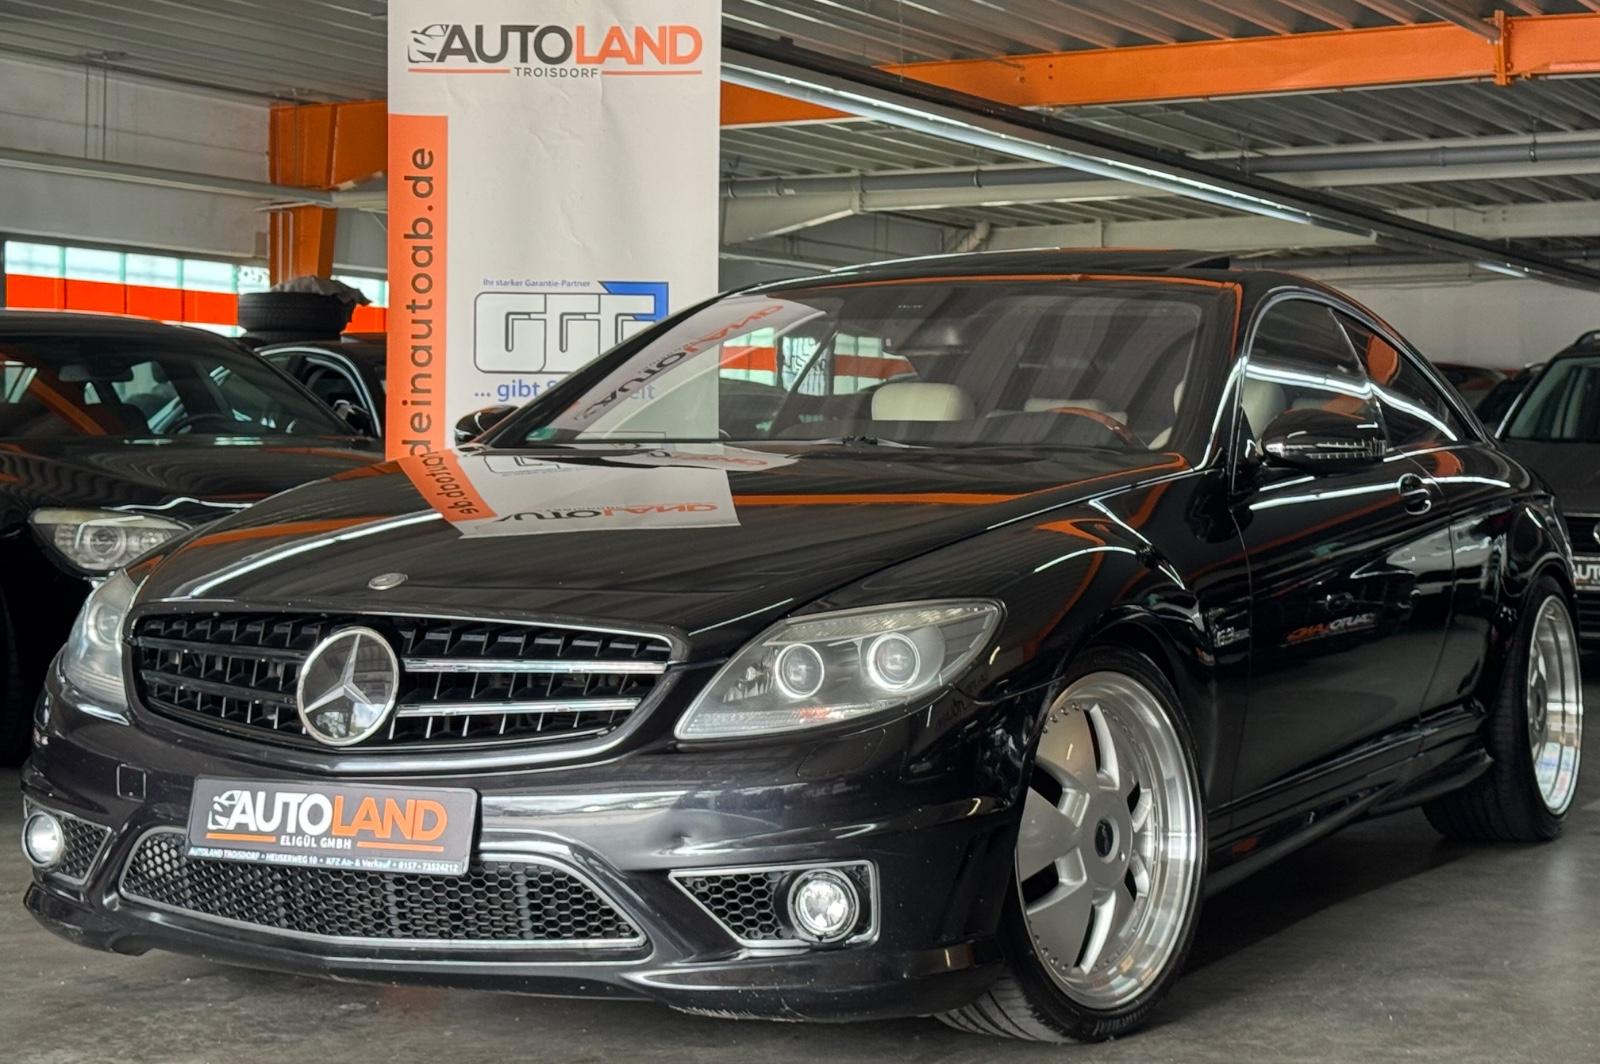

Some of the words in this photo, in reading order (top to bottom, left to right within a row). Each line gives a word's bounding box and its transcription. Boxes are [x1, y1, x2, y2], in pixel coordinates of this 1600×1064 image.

[436, 24, 703, 65] AUTOLAND
[514, 67, 599, 78] TROISDORF
[483, 279, 494, 287] Ihr
[495, 279, 523, 287] starker
[524, 280, 590, 288] Garantie-Partner
[402, 148, 434, 456] deinautoab.de
[497, 379, 540, 401] gibt
[224, 790, 448, 841] AUTOLAND
[280, 834, 317, 848] ELIGÜL
[320, 837, 352, 849] GMBH
